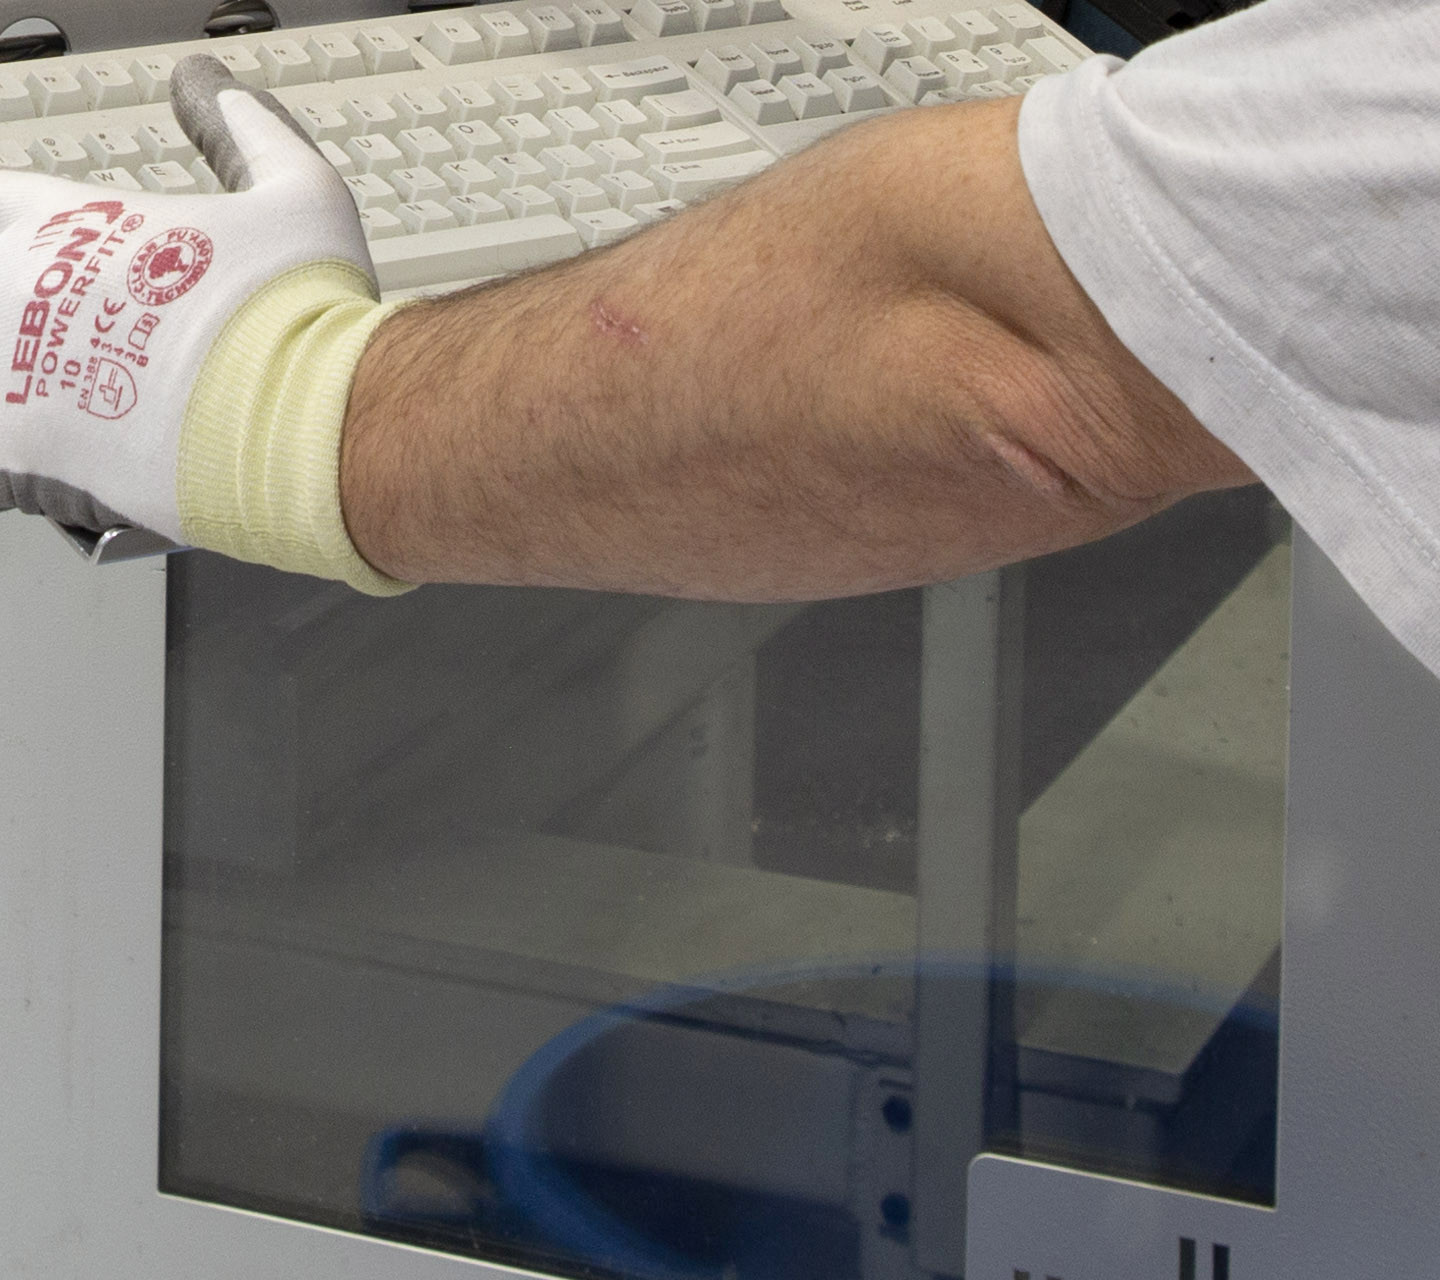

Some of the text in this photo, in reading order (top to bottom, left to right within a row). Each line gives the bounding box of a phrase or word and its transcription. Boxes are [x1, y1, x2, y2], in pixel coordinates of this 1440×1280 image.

[5, 227, 102, 405] LEBON
[59, 359, 81, 389] 10
[77, 355, 98, 411] EN 388
